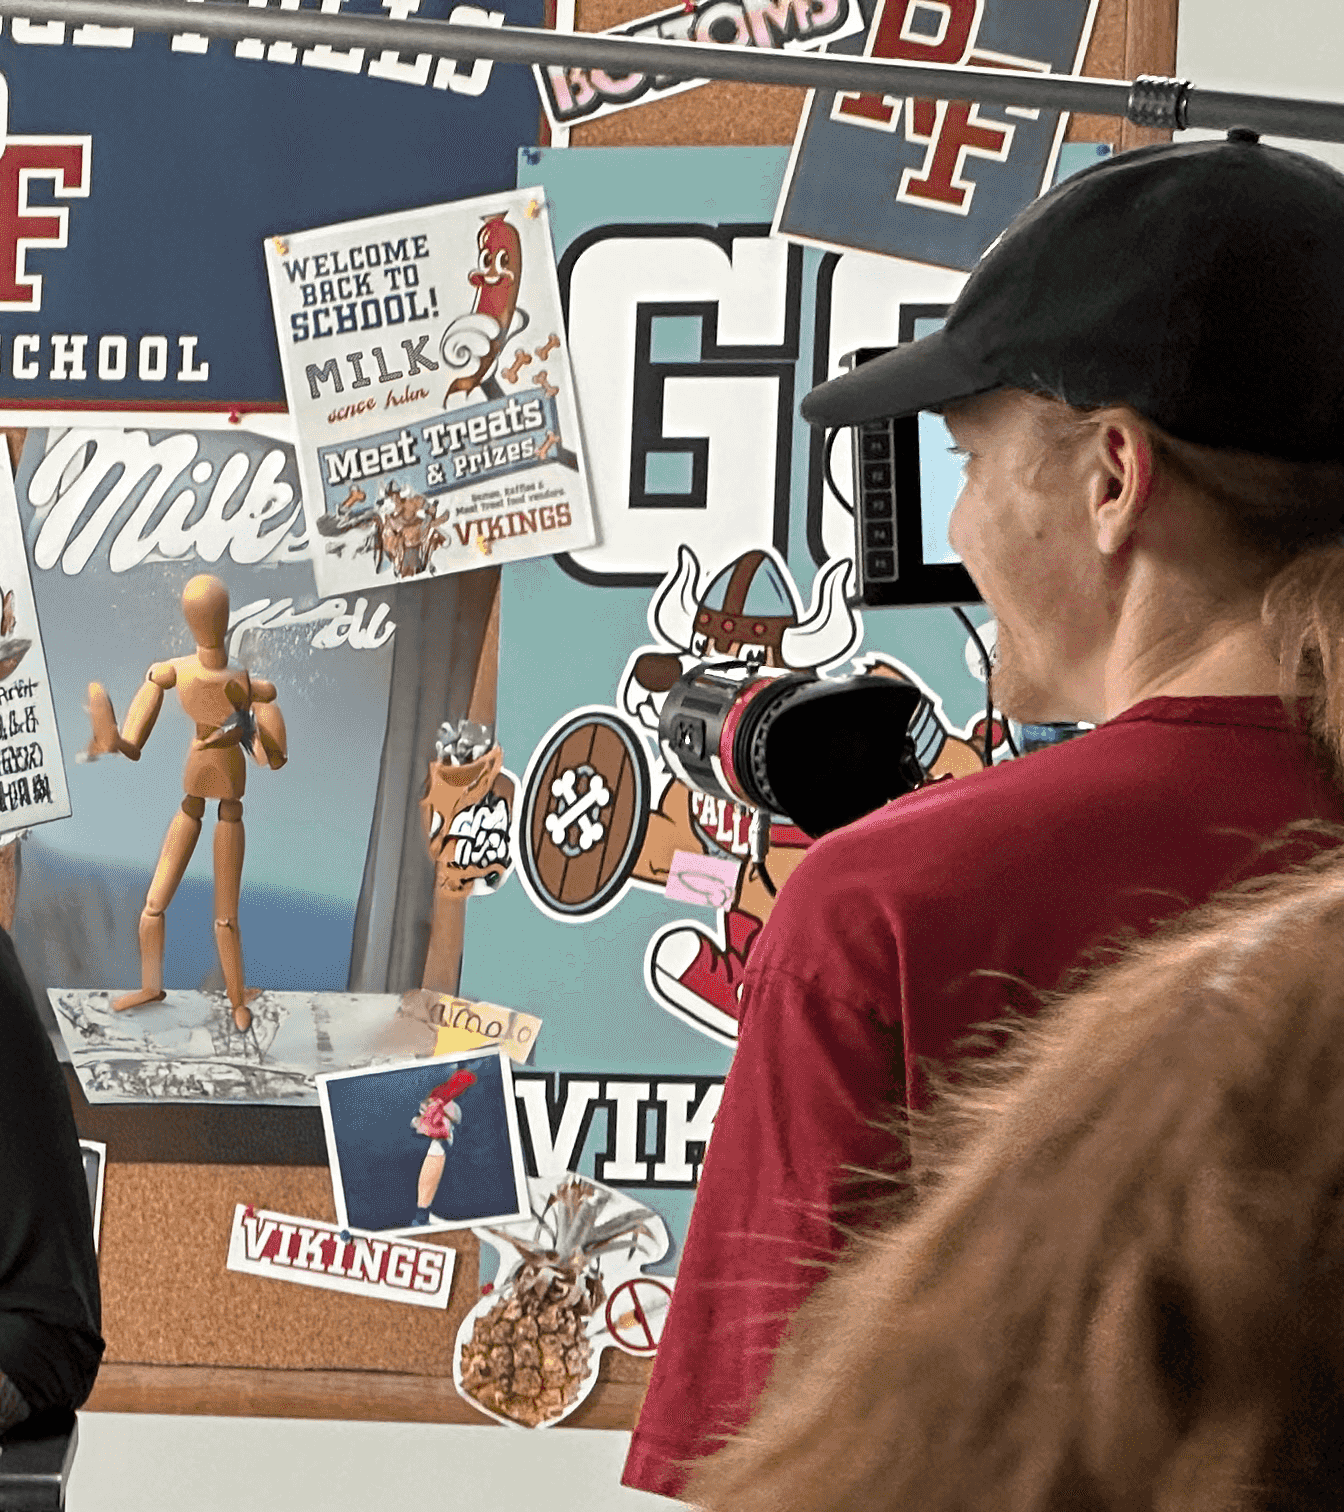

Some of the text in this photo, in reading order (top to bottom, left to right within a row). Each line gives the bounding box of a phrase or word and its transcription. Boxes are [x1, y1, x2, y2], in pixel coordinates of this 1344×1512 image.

[282, 234, 430, 283] WELCOME
[300, 263, 419, 308] BACK TO
[291, 287, 440, 344] SCHOOL!
[304, 335, 440, 400] MILK
[323, 430, 418, 486] Meat
[422, 397, 545, 457] Treats
[452, 438, 535, 479] Prizes
[453, 502, 572, 547] VIKINGS
[241, 1216, 446, 1296] VIKINGS
